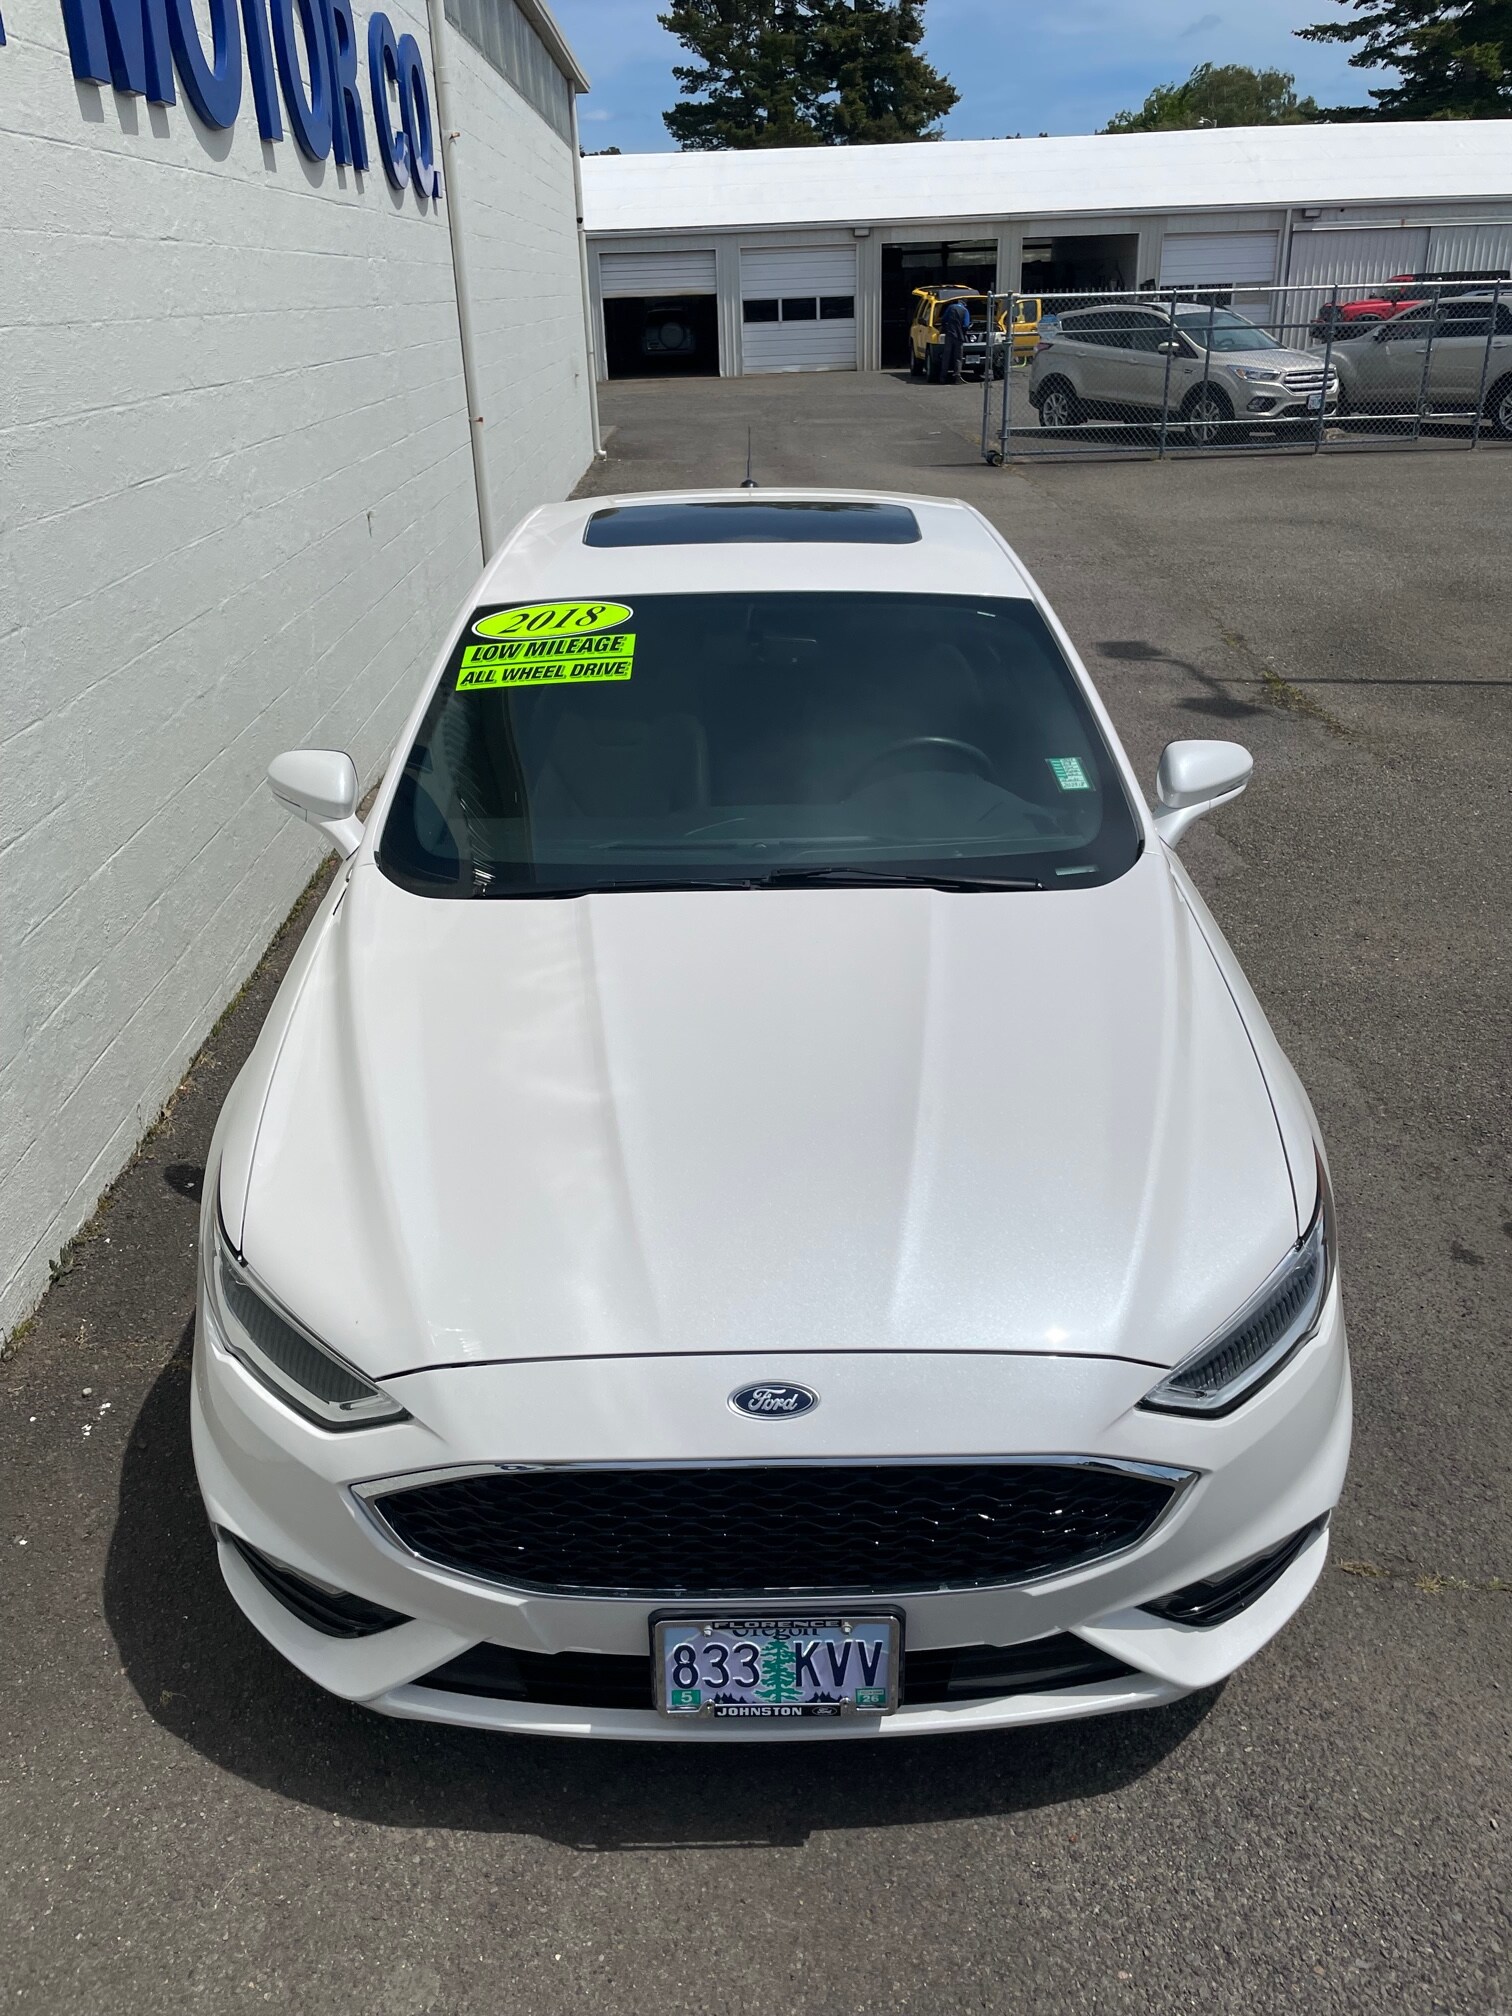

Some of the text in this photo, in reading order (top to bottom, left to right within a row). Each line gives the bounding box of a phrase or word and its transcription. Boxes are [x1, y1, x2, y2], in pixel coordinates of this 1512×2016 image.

[62, 0, 369, 172] OOR
[496, 606, 607, 635] 2018
[470, 636, 624, 663] LOW MILEAGE
[461, 661, 630, 686] ALL WHEEL DRIVE
[747, 1388, 799, 1411] Ford
[713, 1620, 840, 1628] FLORENCE
[672, 1640, 883, 1689] 833 KVV
[681, 1691, 693, 1703] 5
[862, 1694, 880, 1703] 26
[717, 1706, 803, 1717] JOHNSTON
